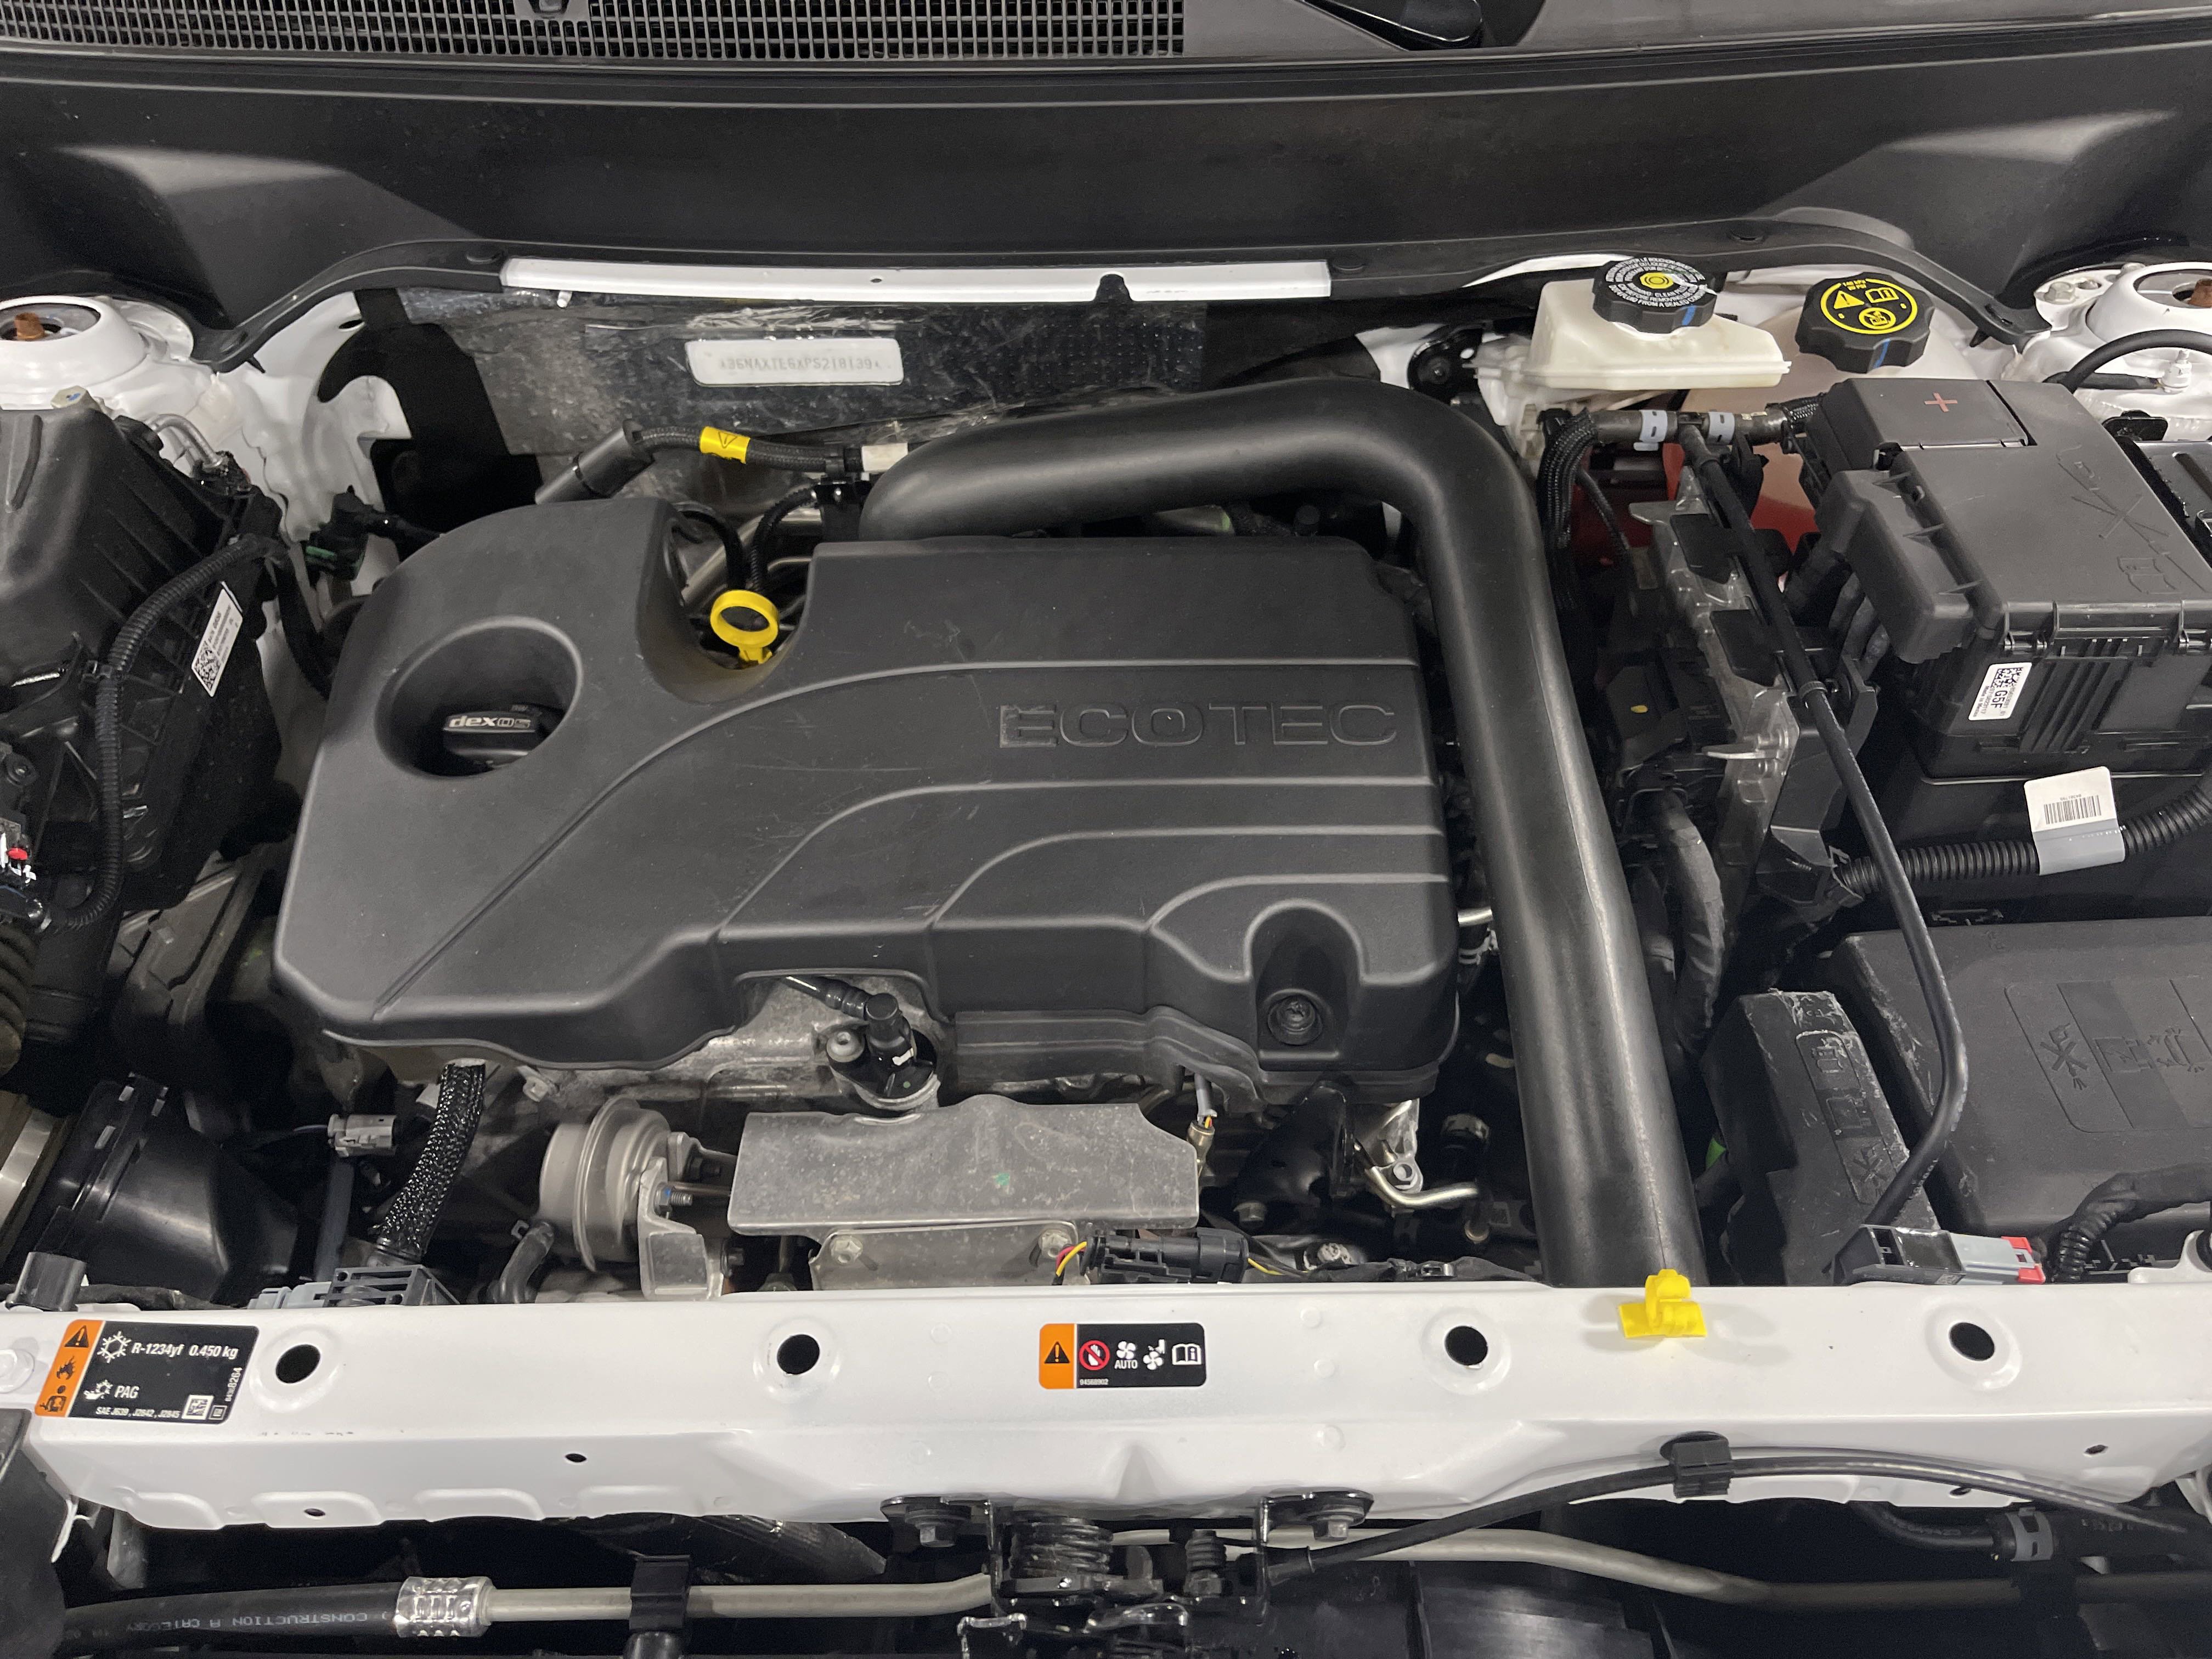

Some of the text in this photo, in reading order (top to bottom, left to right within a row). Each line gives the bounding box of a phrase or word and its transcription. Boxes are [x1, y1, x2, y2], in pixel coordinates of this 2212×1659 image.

[1990, 690, 2008, 709] G5F
[448, 715, 532, 729] dexos
[999, 702, 1398, 749] ECOTEC
[131, 1342, 238, 1360] R-1234yf 0.450 kg
[1114, 1359, 1138, 1370] AUTO
[114, 1385, 139, 1399] PAG
[95, 1406, 111, 1415] SAE
[209, 1618, 221, 1628] A
[231, 1612, 368, 1627] CONSTRUCTION
